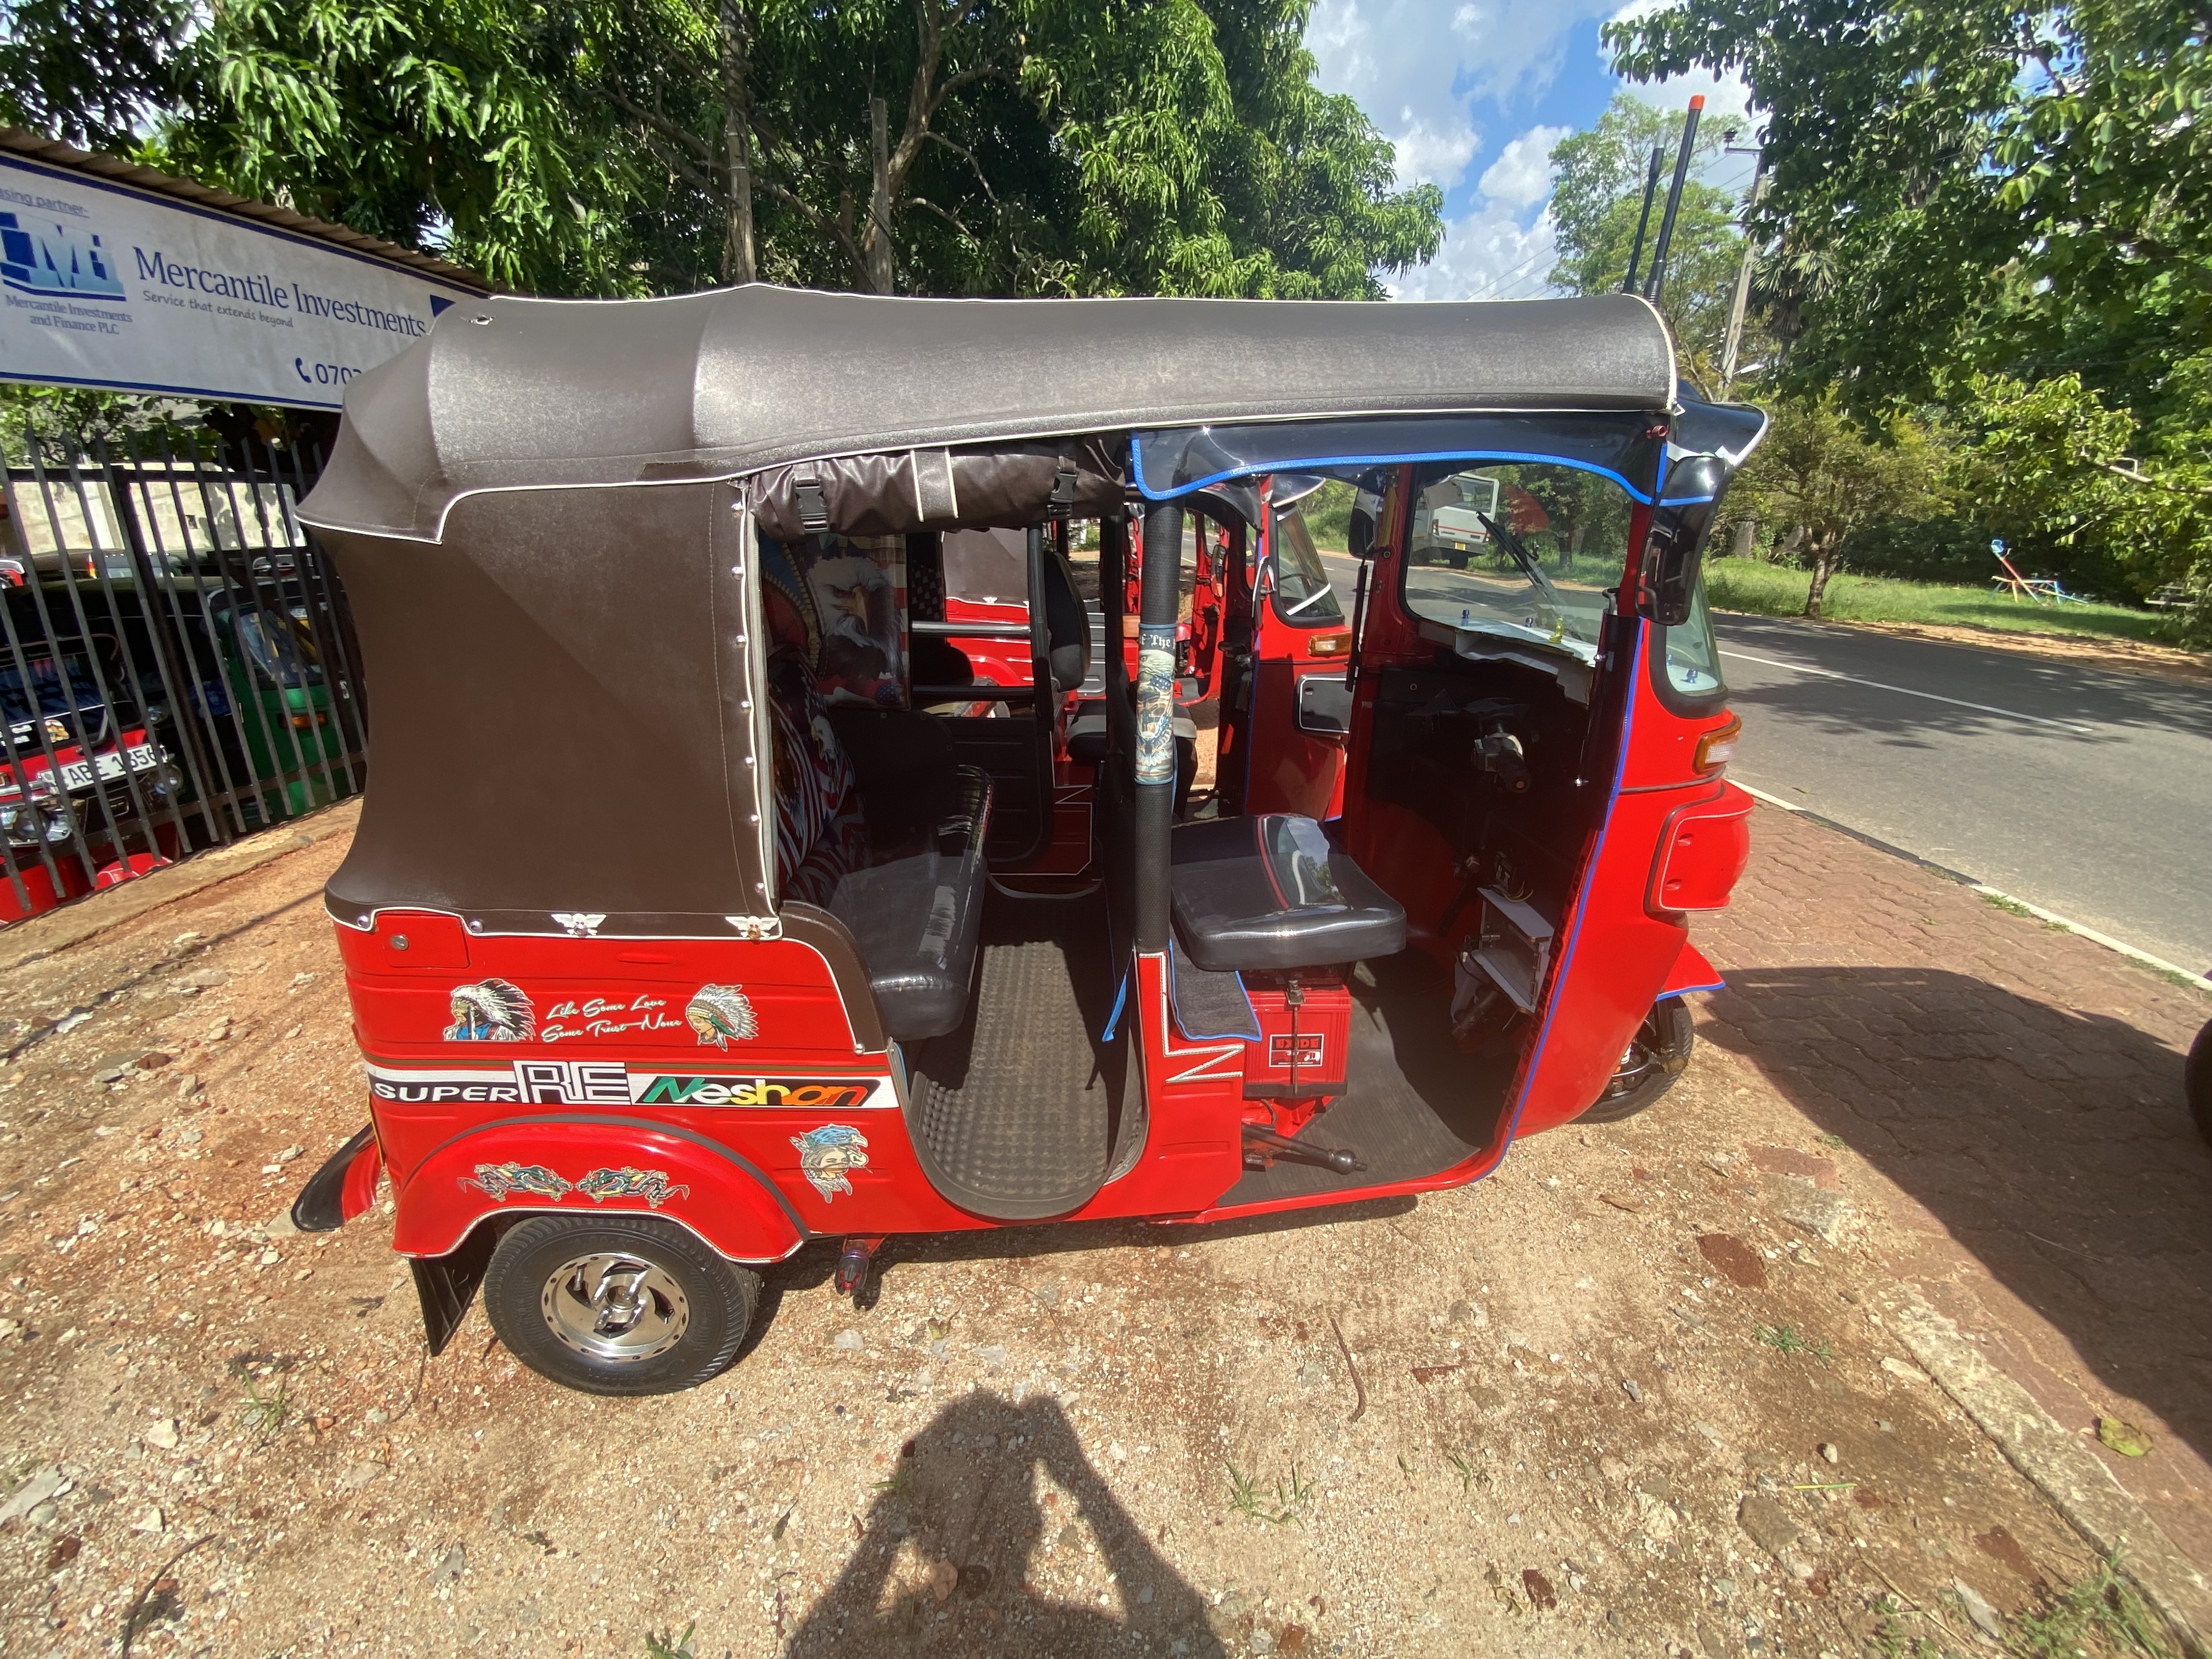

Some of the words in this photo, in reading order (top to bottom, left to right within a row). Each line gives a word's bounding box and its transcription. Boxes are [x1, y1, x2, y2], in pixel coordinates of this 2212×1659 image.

[132, 246, 289, 308] Mercantile
[292, 283, 427, 337] Investments
[5, 295, 67, 313] Mercantile
[68, 303, 133, 323] Investments
[143, 290, 185, 307] Service
[189, 298, 213, 313] that
[217, 305, 256, 321] extends
[259, 311, 294, 328] beyond
[30, 314, 52, 326] and
[53, 316, 96, 331] Finance
[98, 321, 120, 335] PLC
[315, 363, 362, 385] 070
[1150, 634, 1171, 649] The
[546, 1000, 580, 1020] Like
[582, 998, 625, 1018] Some
[630, 994, 667, 1011] Love
[541, 1024, 584, 1042] Some
[586, 1019, 627, 1037] Trust
[641, 1013, 682, 1030] None
[375, 1082, 518, 1102] SUPER
[512, 1060, 631, 1105] RE
